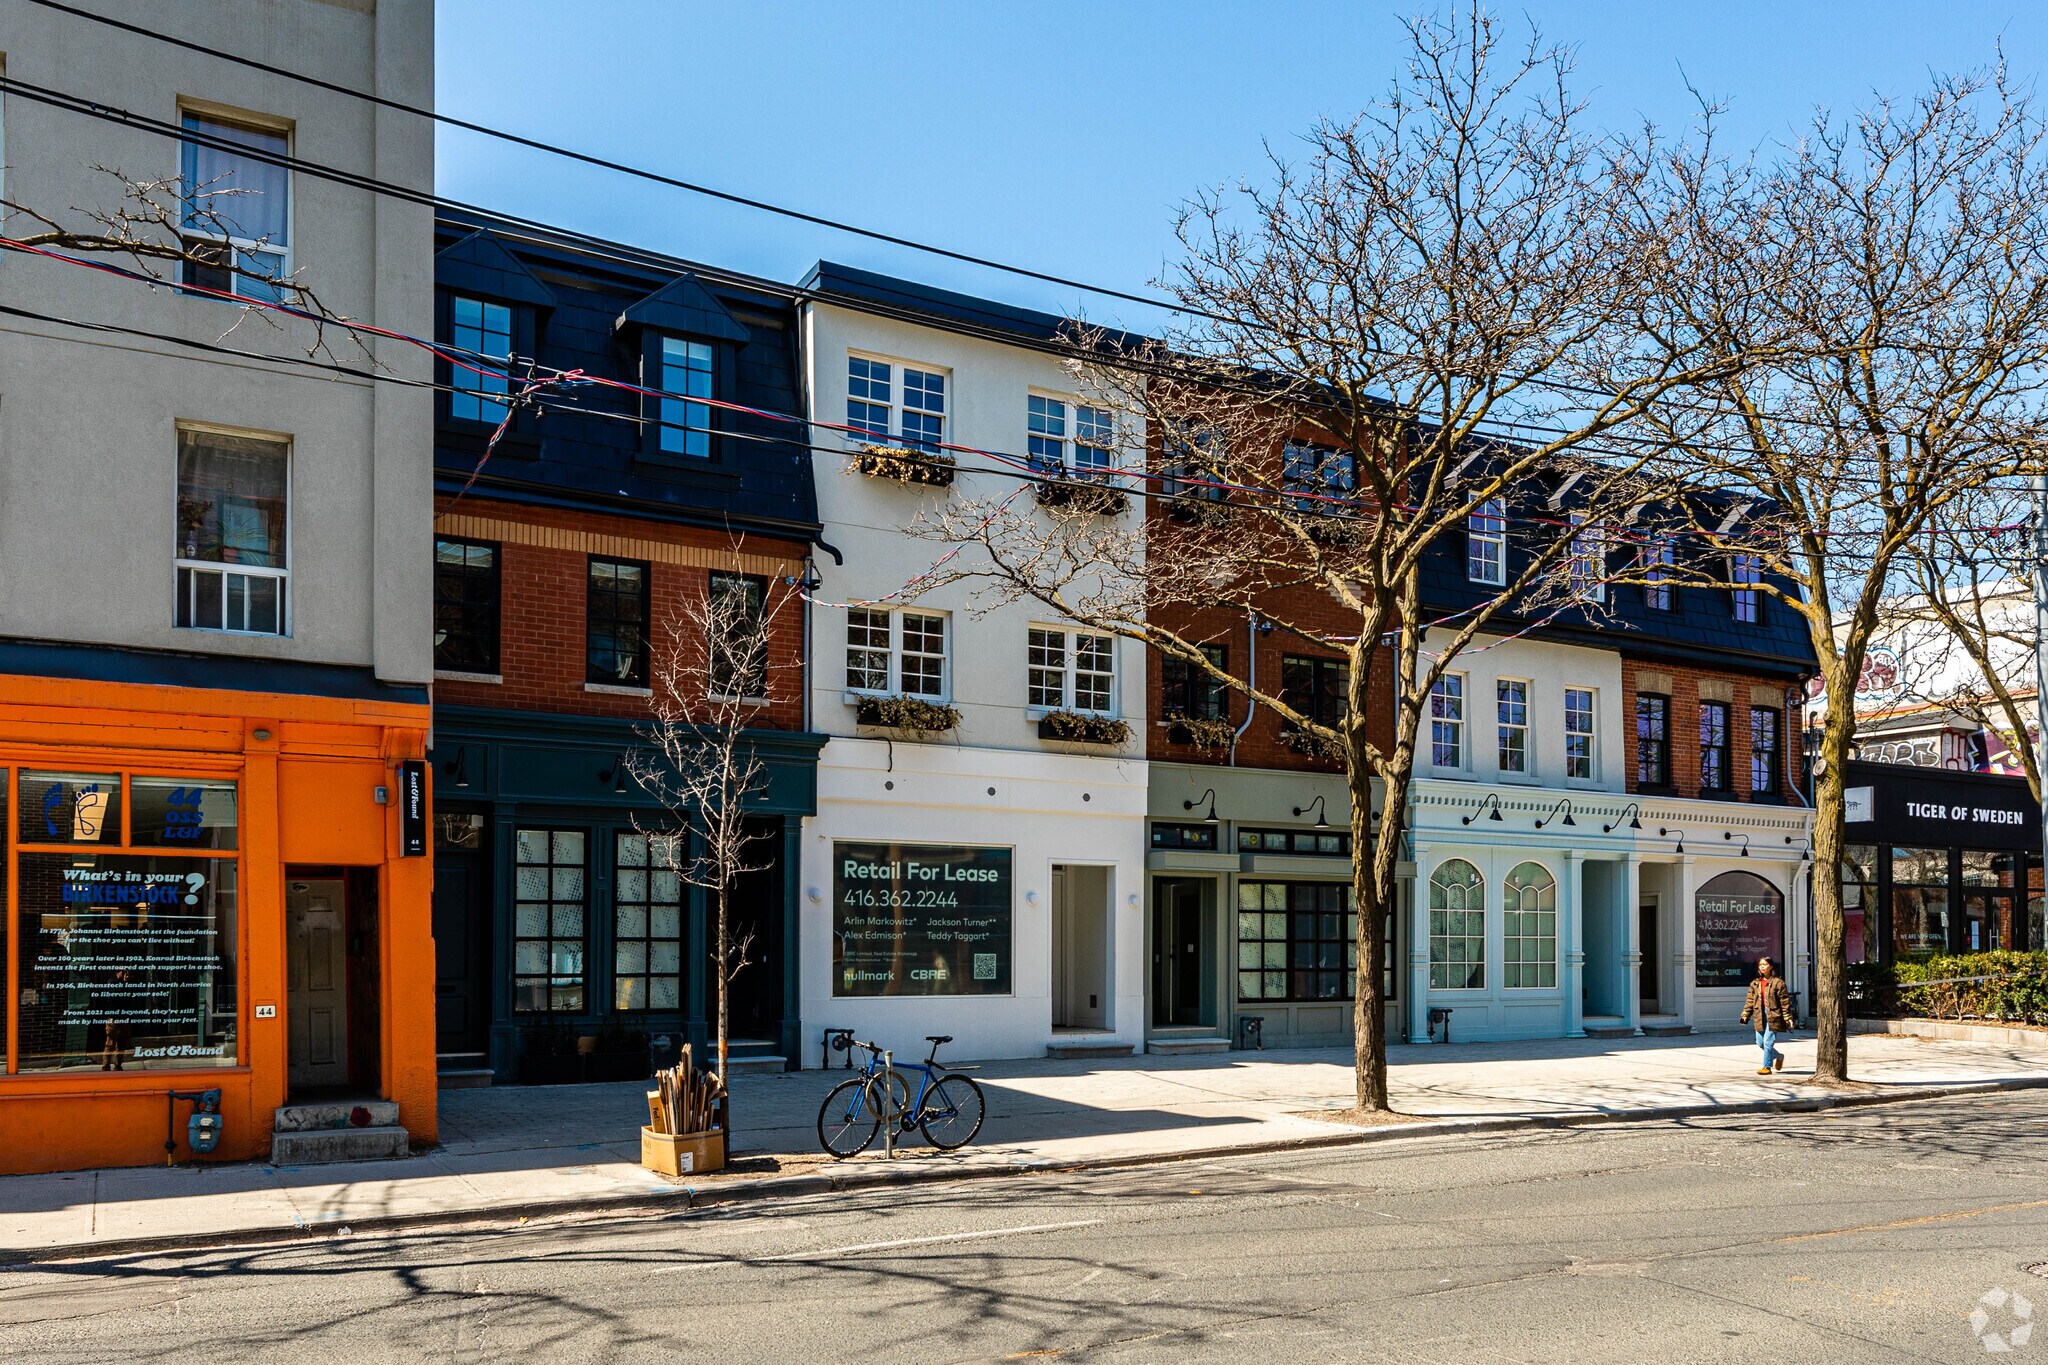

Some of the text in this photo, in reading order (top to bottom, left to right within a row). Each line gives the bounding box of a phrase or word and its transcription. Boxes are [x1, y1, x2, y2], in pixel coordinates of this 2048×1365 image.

[166, 786, 202, 808] 44
[410, 772, 419, 819] Lost&Found
[1906, 802, 2024, 824] TIGER OF SWEDEN
[63, 870, 184, 884] What's in your
[844, 860, 999, 882] Retail For Lease
[62, 884, 179, 904] BIRKENSTOCK
[844, 889, 959, 908] 416.362.2244
[1699, 900, 1776, 914] Retail For Lease
[844, 917, 865, 926] Arlin
[926, 918, 962, 926] Jackson
[844, 931, 864, 940] Alex
[926, 932, 952, 942] Teddy
[844, 970, 946, 980] hullmark CBRE
[258, 1008, 272, 1016] 44
[133, 1045, 224, 1058] Lost&Found
